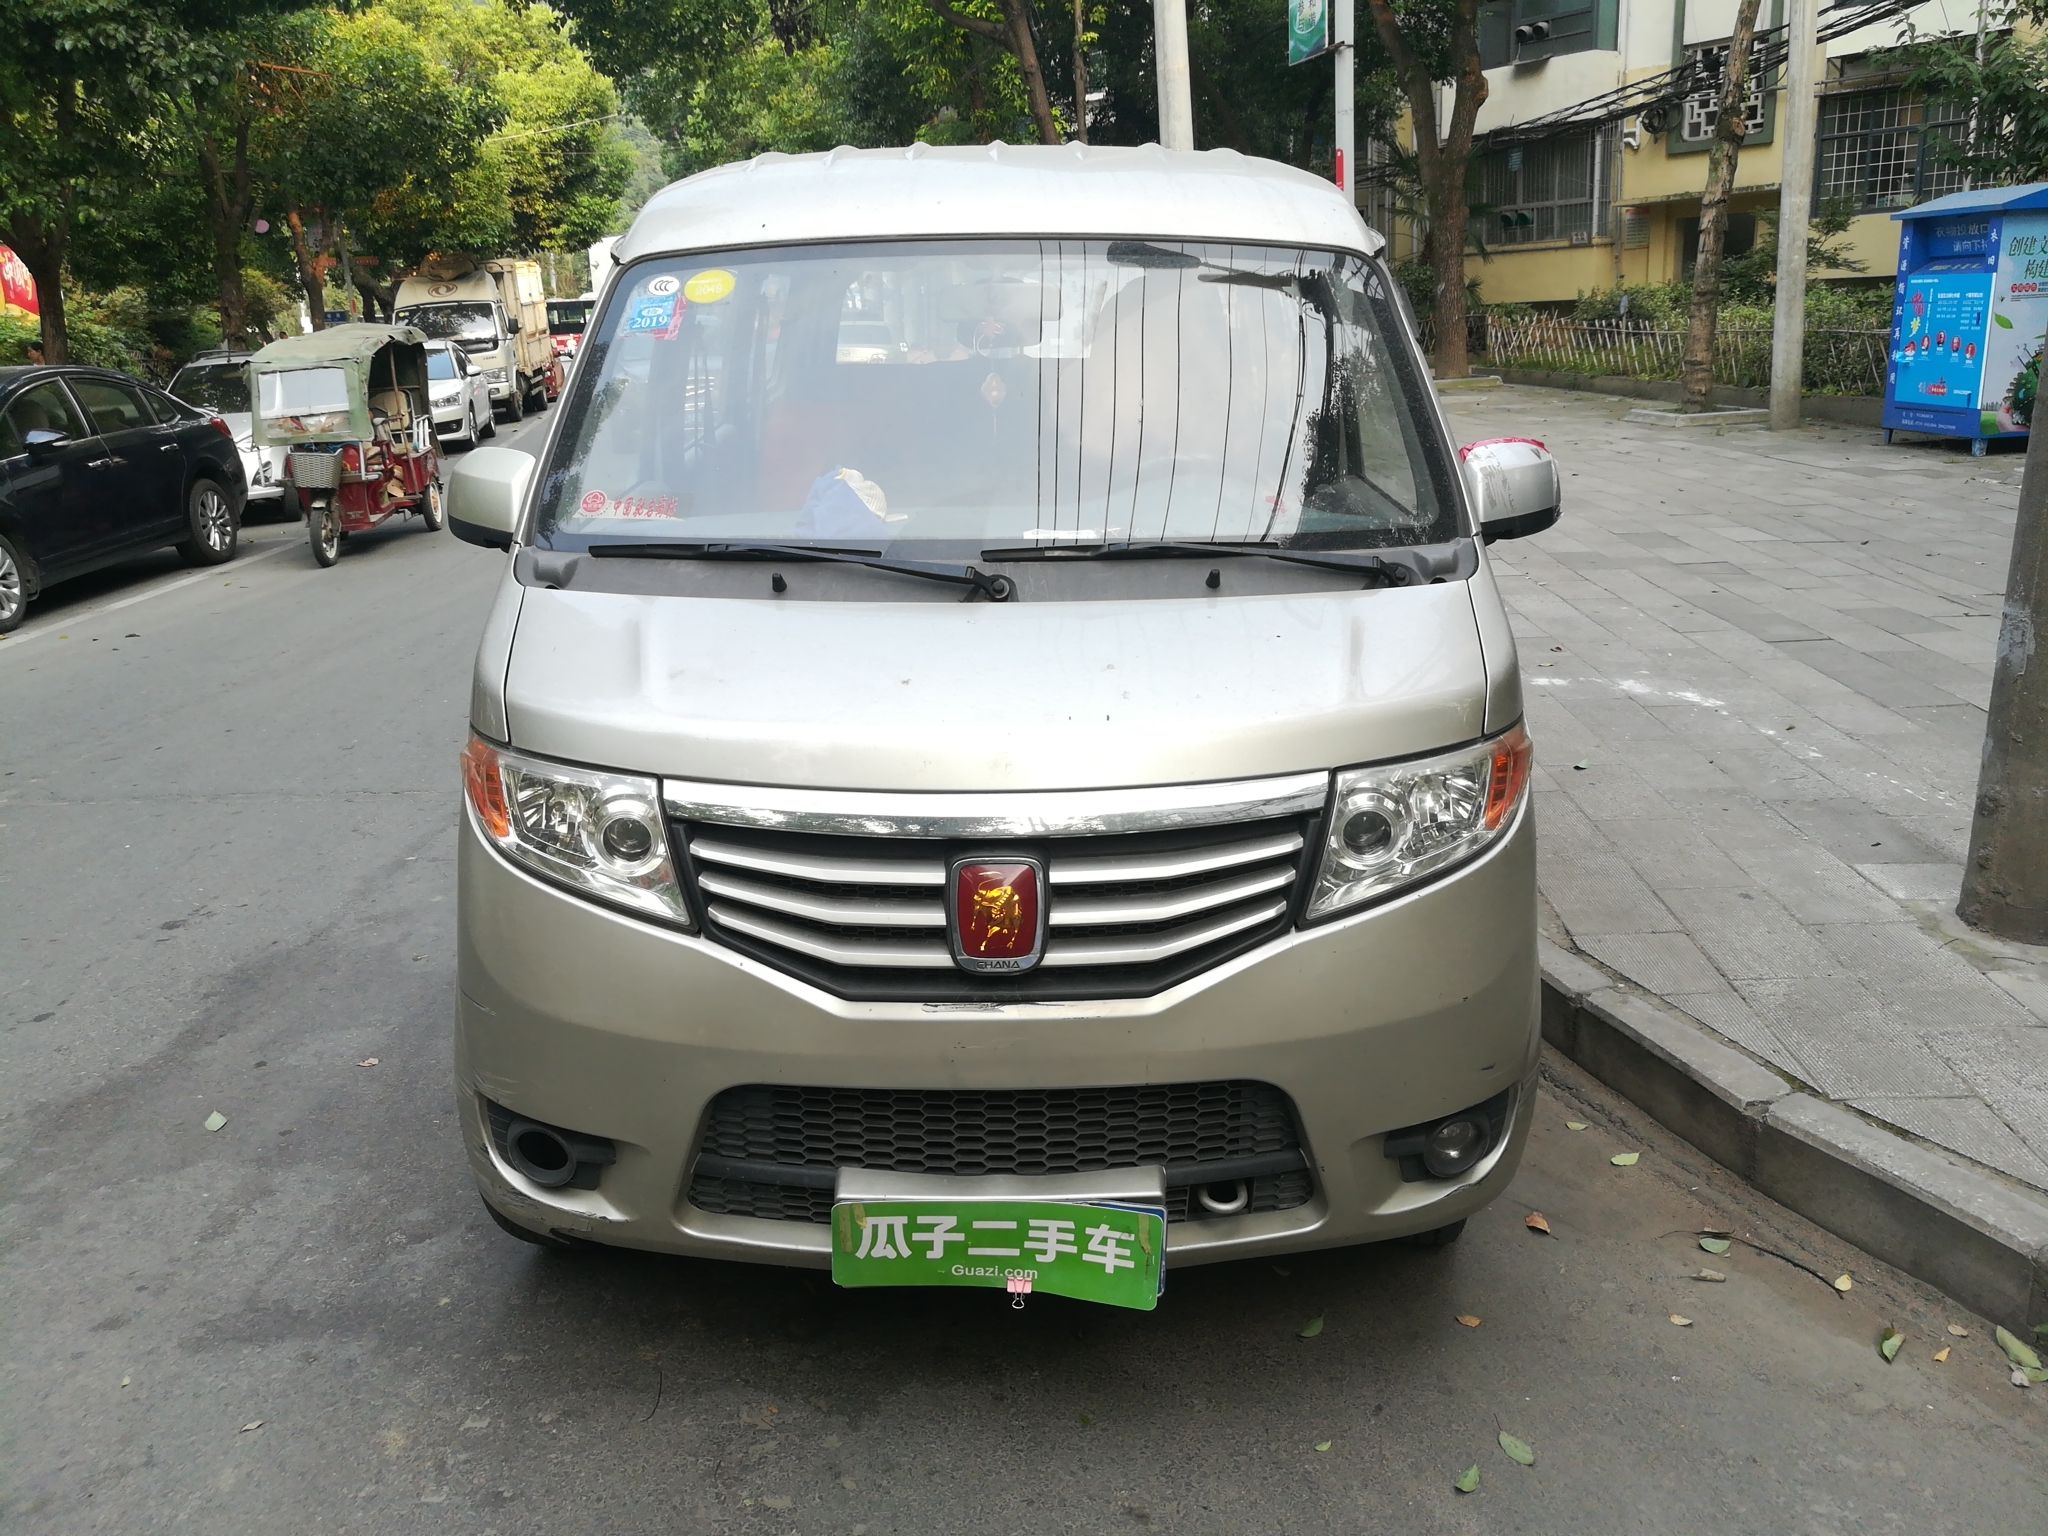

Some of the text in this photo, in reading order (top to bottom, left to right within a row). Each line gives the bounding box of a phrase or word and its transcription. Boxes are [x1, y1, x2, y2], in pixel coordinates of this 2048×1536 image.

[631, 315, 668, 329] 2019
[976, 960, 1020, 970] CHANA
[855, 1215, 1135, 1274] 瓜子二手车
[951, 1264, 1038, 1279] Guazi.com
